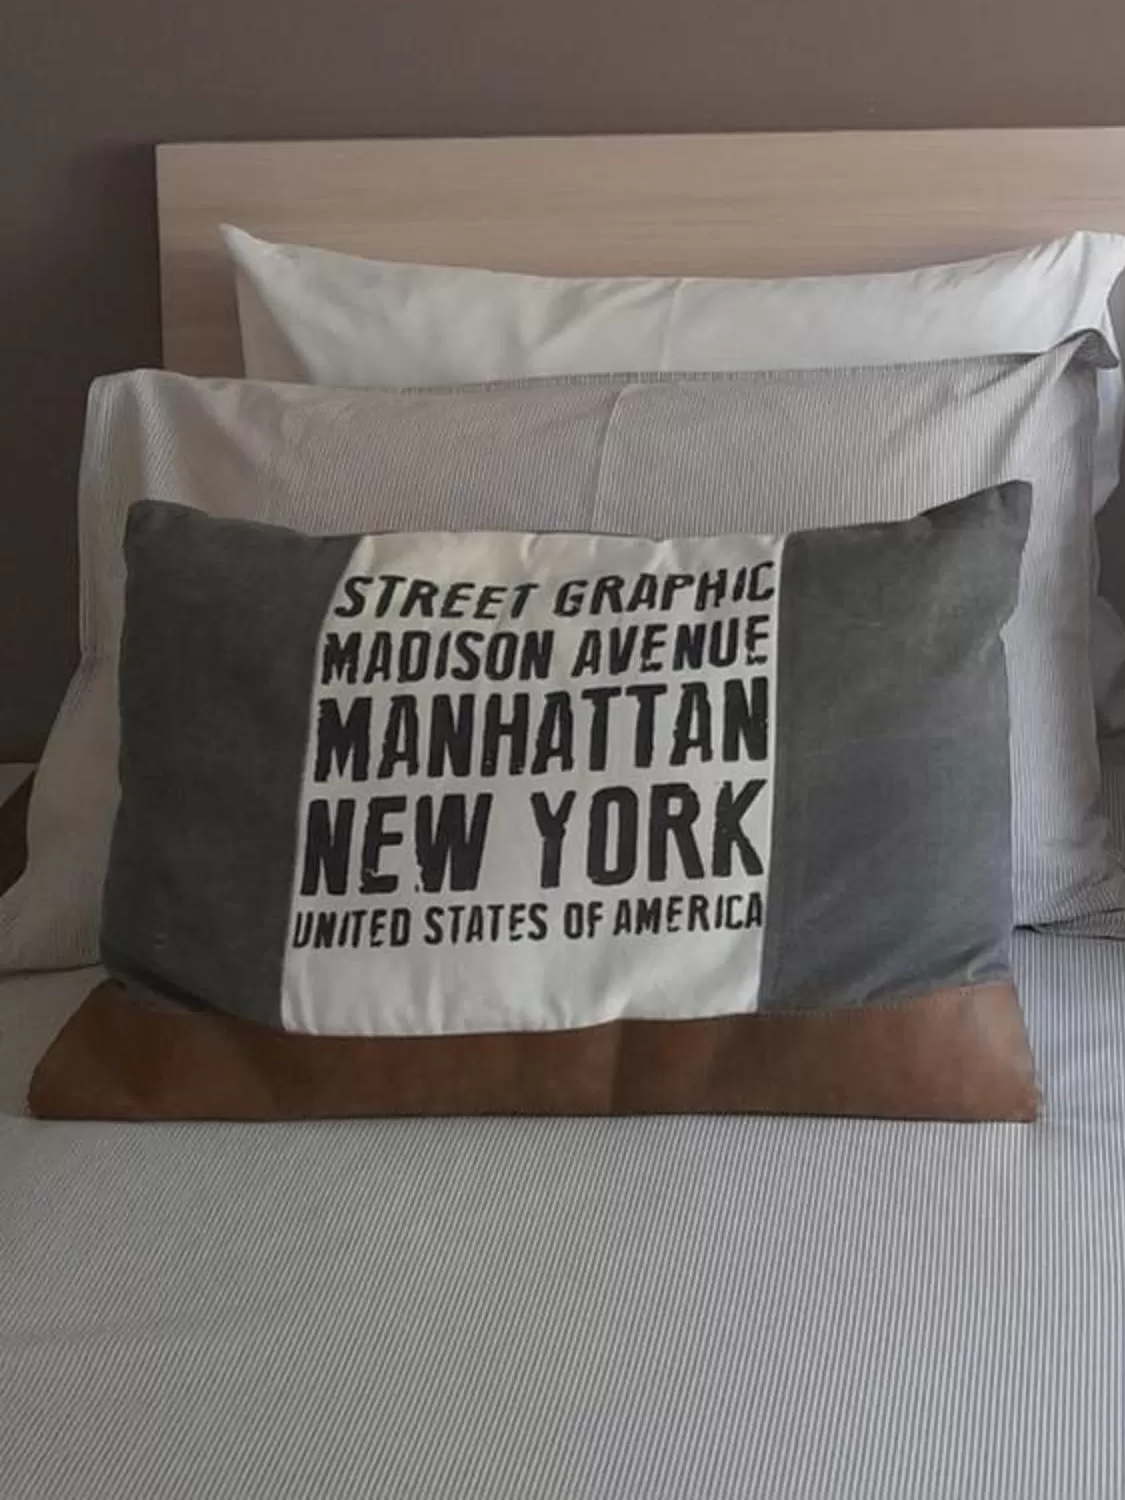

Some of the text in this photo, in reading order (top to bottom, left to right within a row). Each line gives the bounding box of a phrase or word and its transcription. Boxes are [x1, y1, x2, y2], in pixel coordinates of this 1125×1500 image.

[334, 561, 776, 620] STREET GRAPHIC
[320, 615, 771, 685] MADISON AVENUE
[313, 676, 769, 783] MANHATTAN
[300, 779, 768, 896] NEW YORK
[292, 892, 764, 949] UNITED STATES OF AMERICA
